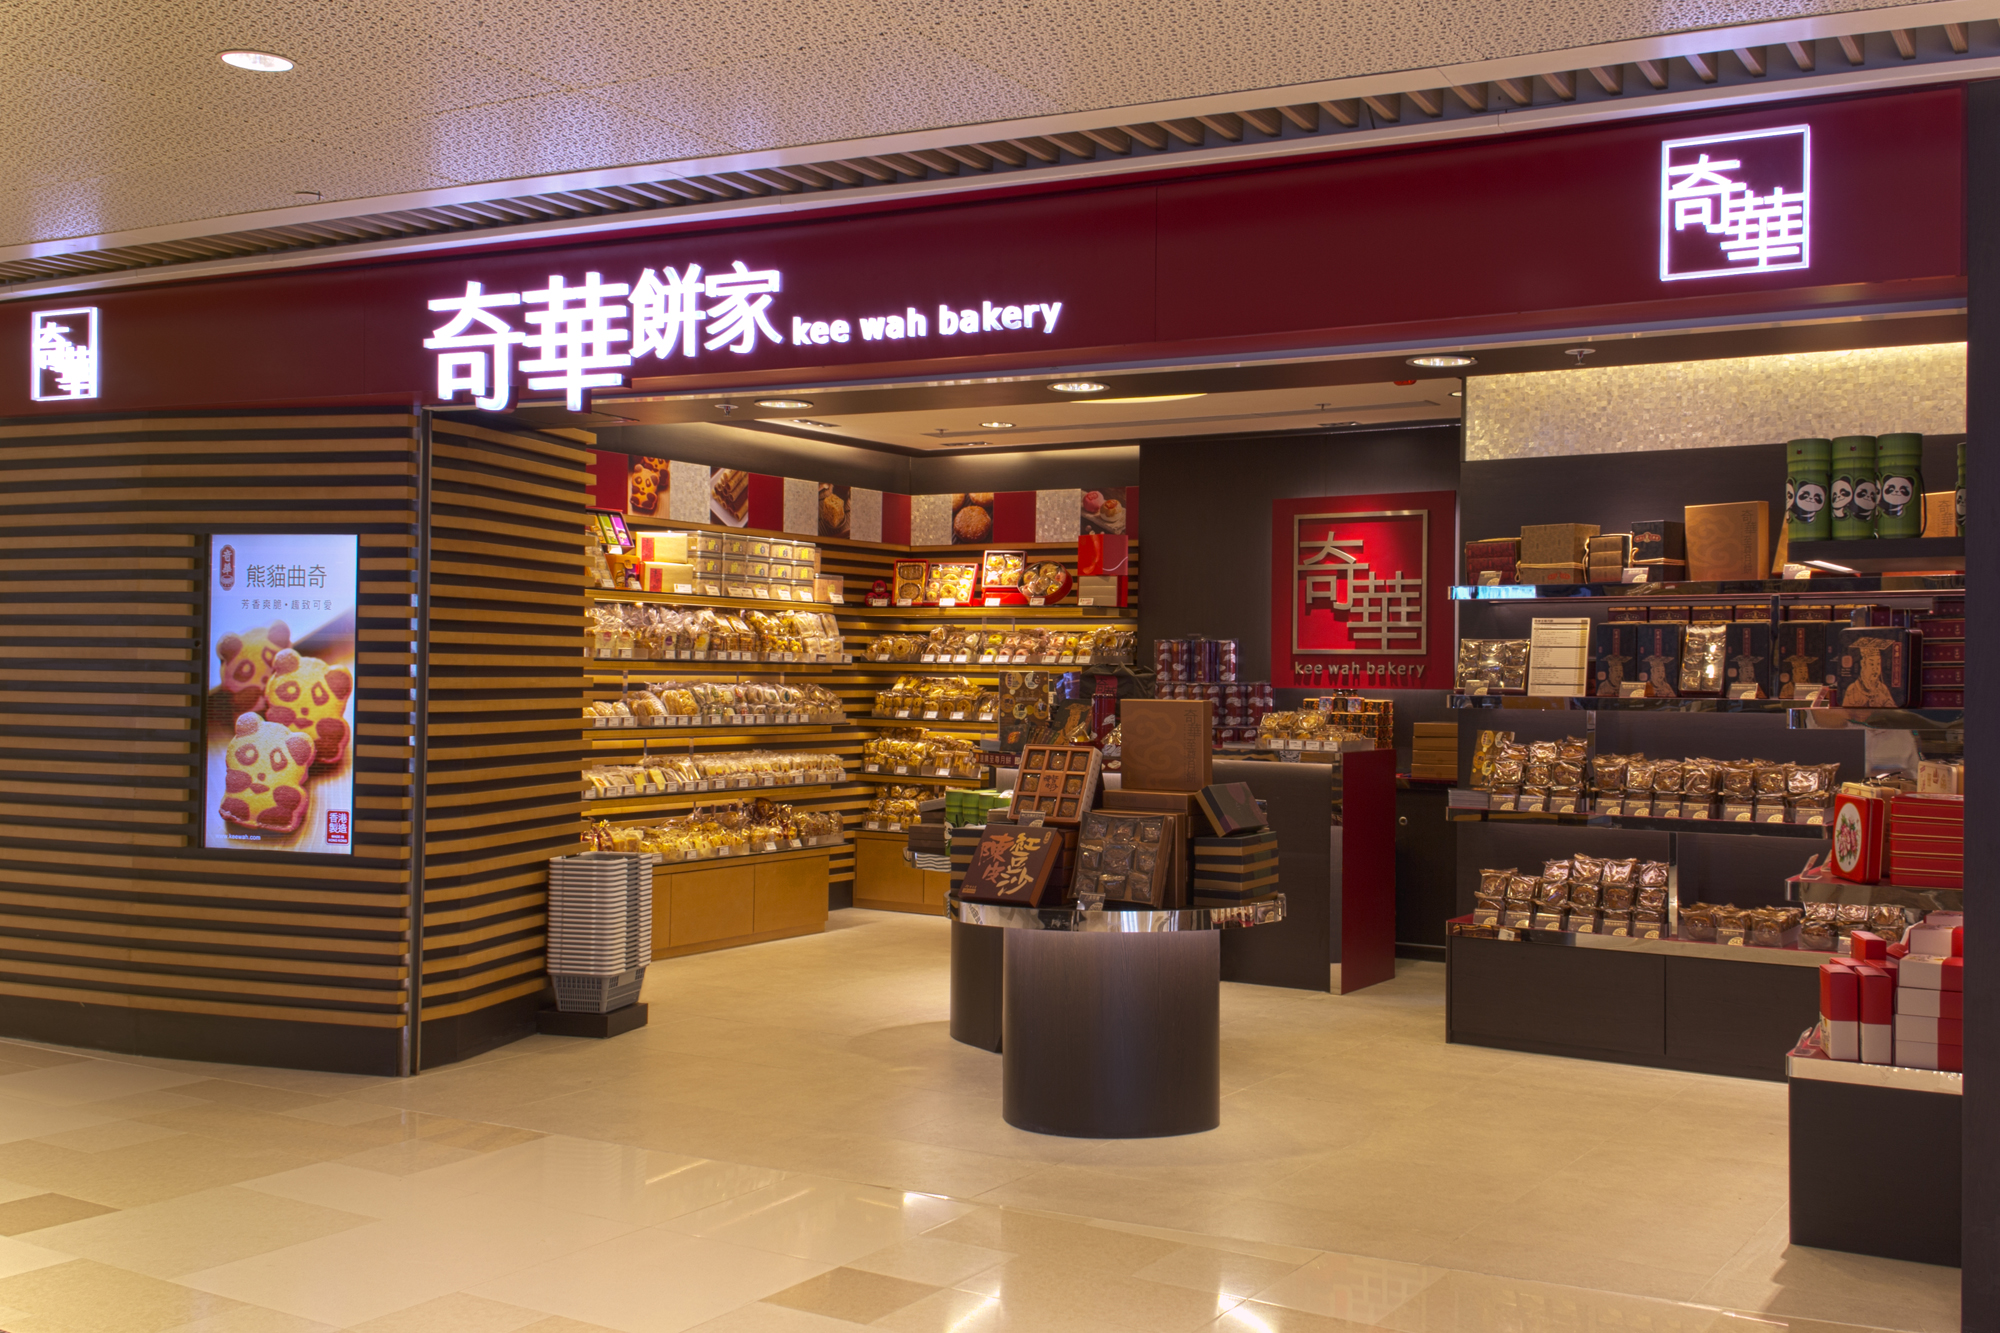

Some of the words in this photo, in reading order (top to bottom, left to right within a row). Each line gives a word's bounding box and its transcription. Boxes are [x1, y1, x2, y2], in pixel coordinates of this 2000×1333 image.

[1669, 154, 1804, 266] 奇華
[423, 260, 783, 411] 奇華餅家
[793, 316, 850, 345] kee
[859, 307, 927, 340] wah
[938, 300, 1062, 334] bakery
[246, 564, 327, 588] 熊貓曲奇
[1298, 531, 1422, 650] 奇華
[1294, 661, 1323, 675] kee
[1328, 661, 1360, 675] wah
[1366, 661, 1425, 678] bakery
[978, 832, 1015, 884] 陳皮
[996, 832, 1041, 896] 紅豆沙
